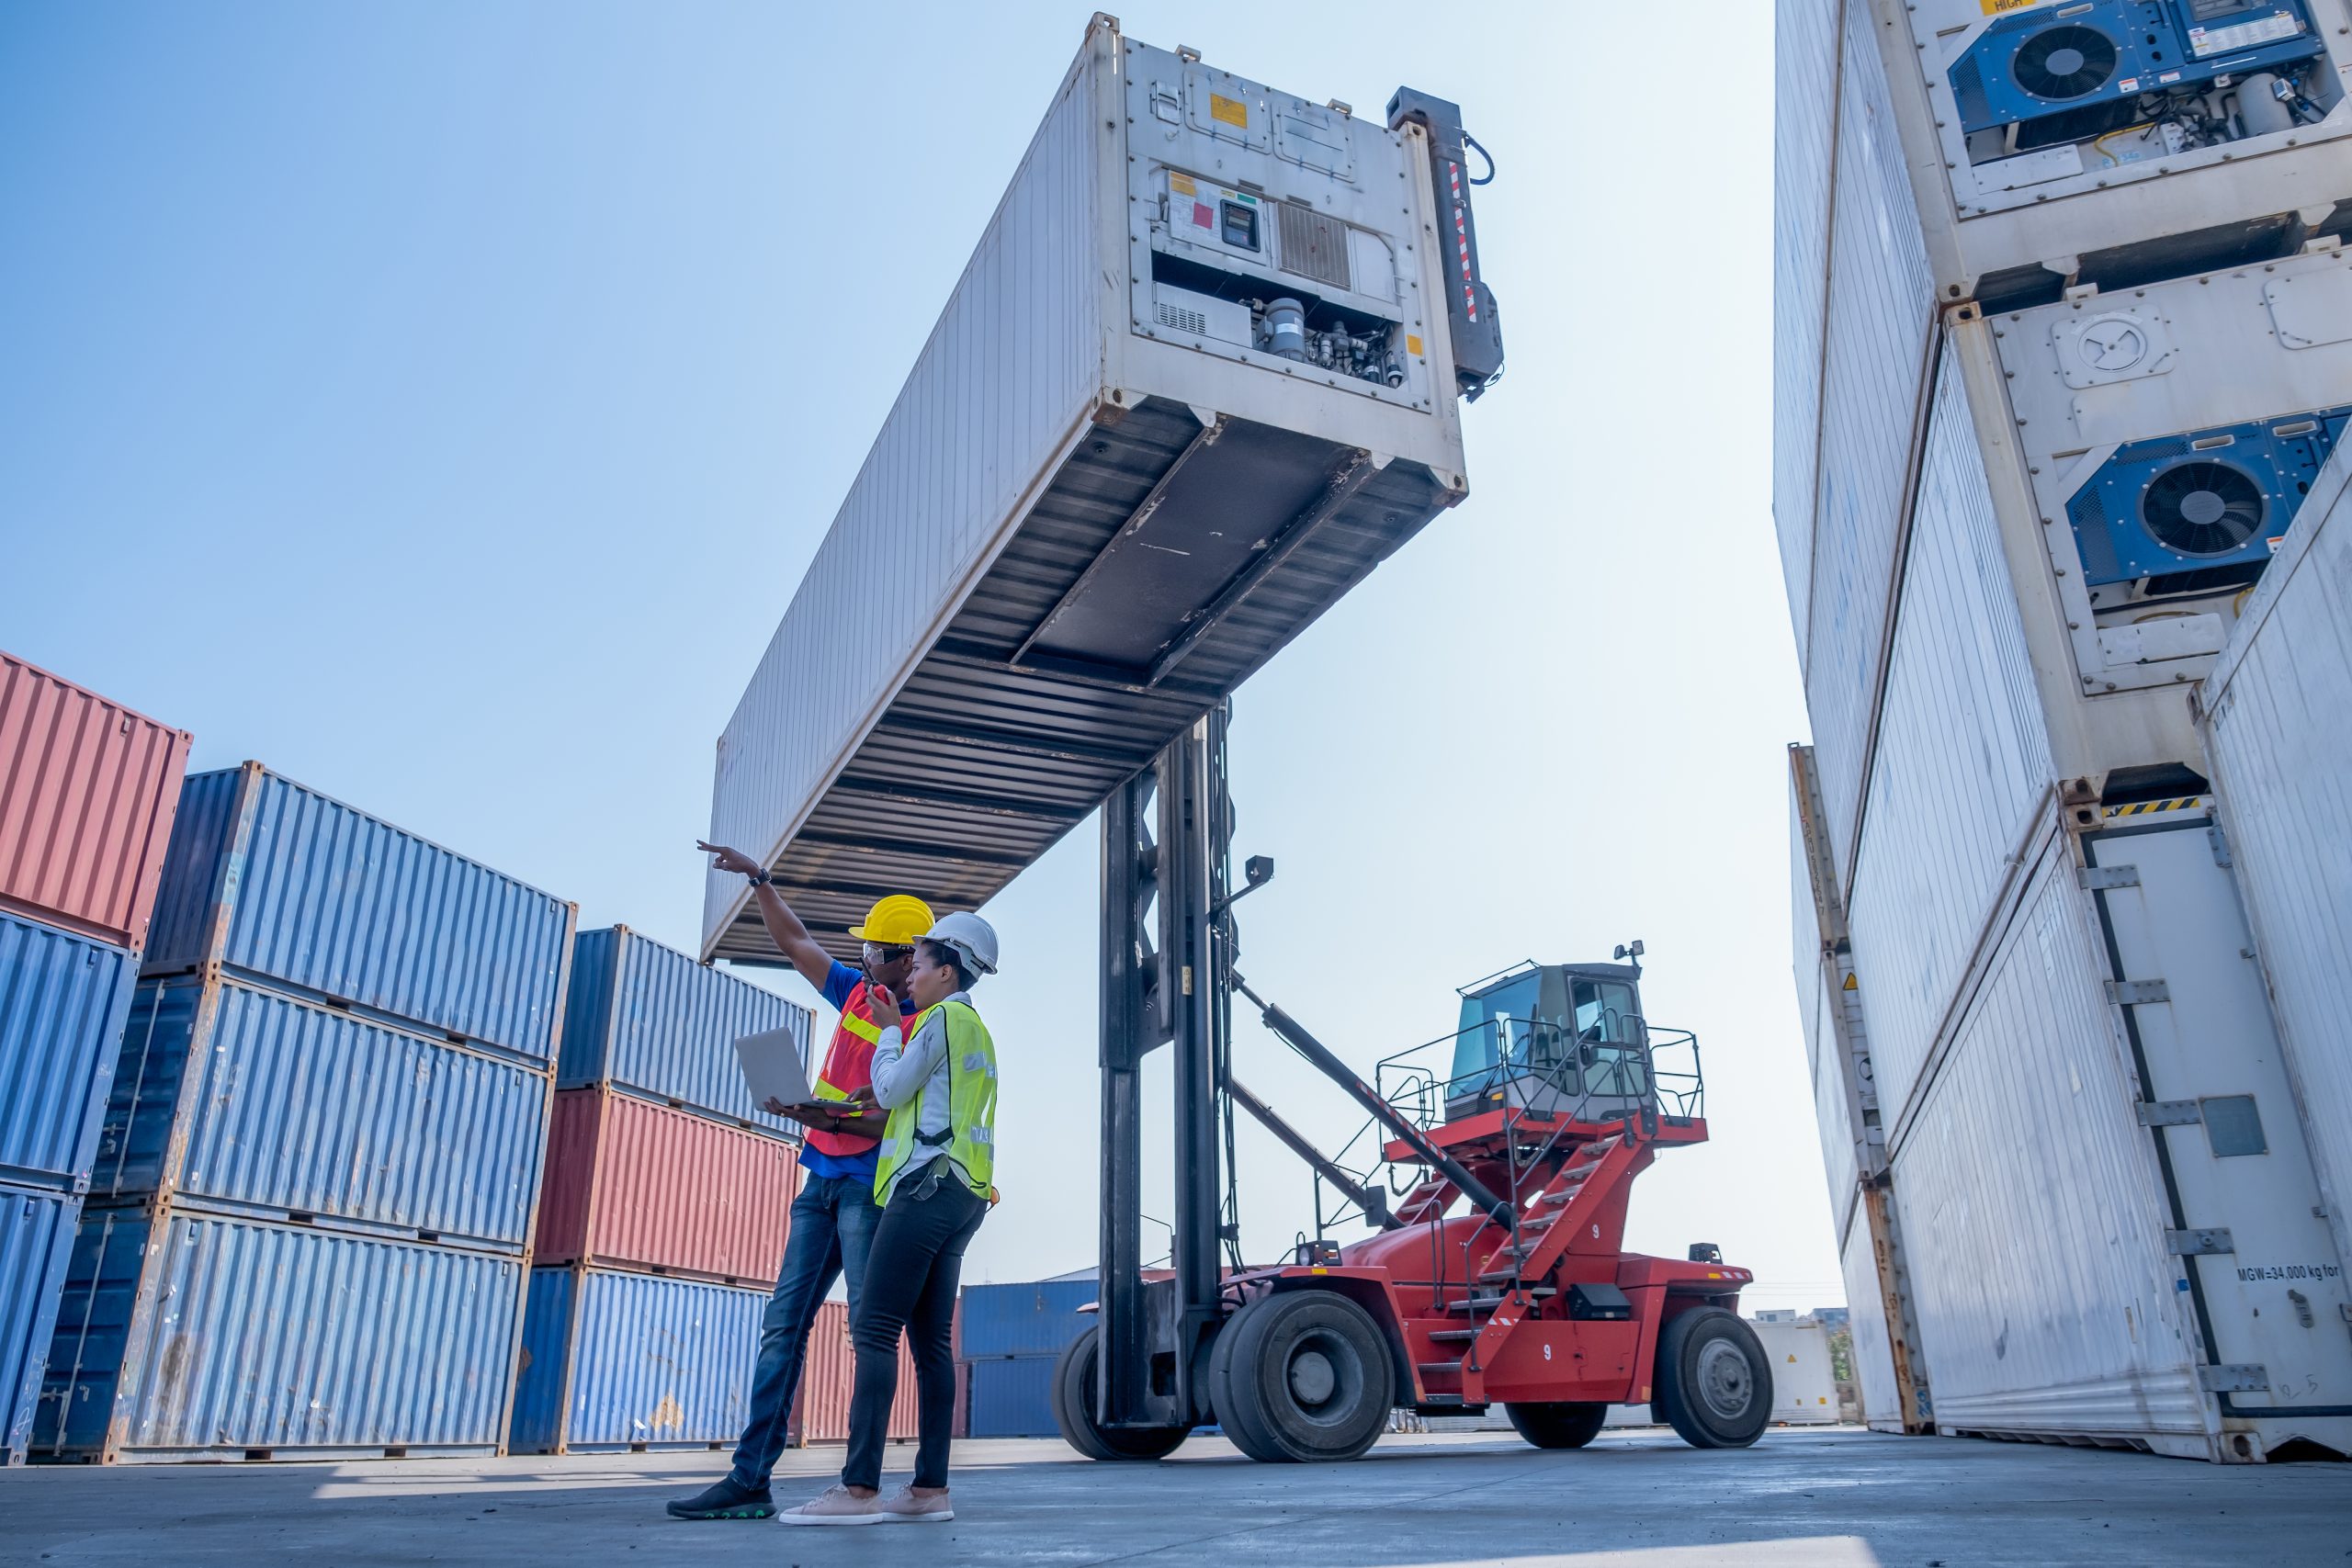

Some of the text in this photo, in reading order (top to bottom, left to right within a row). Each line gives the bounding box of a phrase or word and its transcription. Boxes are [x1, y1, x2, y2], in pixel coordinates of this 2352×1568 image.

[1592, 1224, 1600, 1239] 9
[2307, 1265, 2323, 1280] kg
[2323, 1264, 2338, 1278] for
[1544, 1344, 1552, 1360] 9
